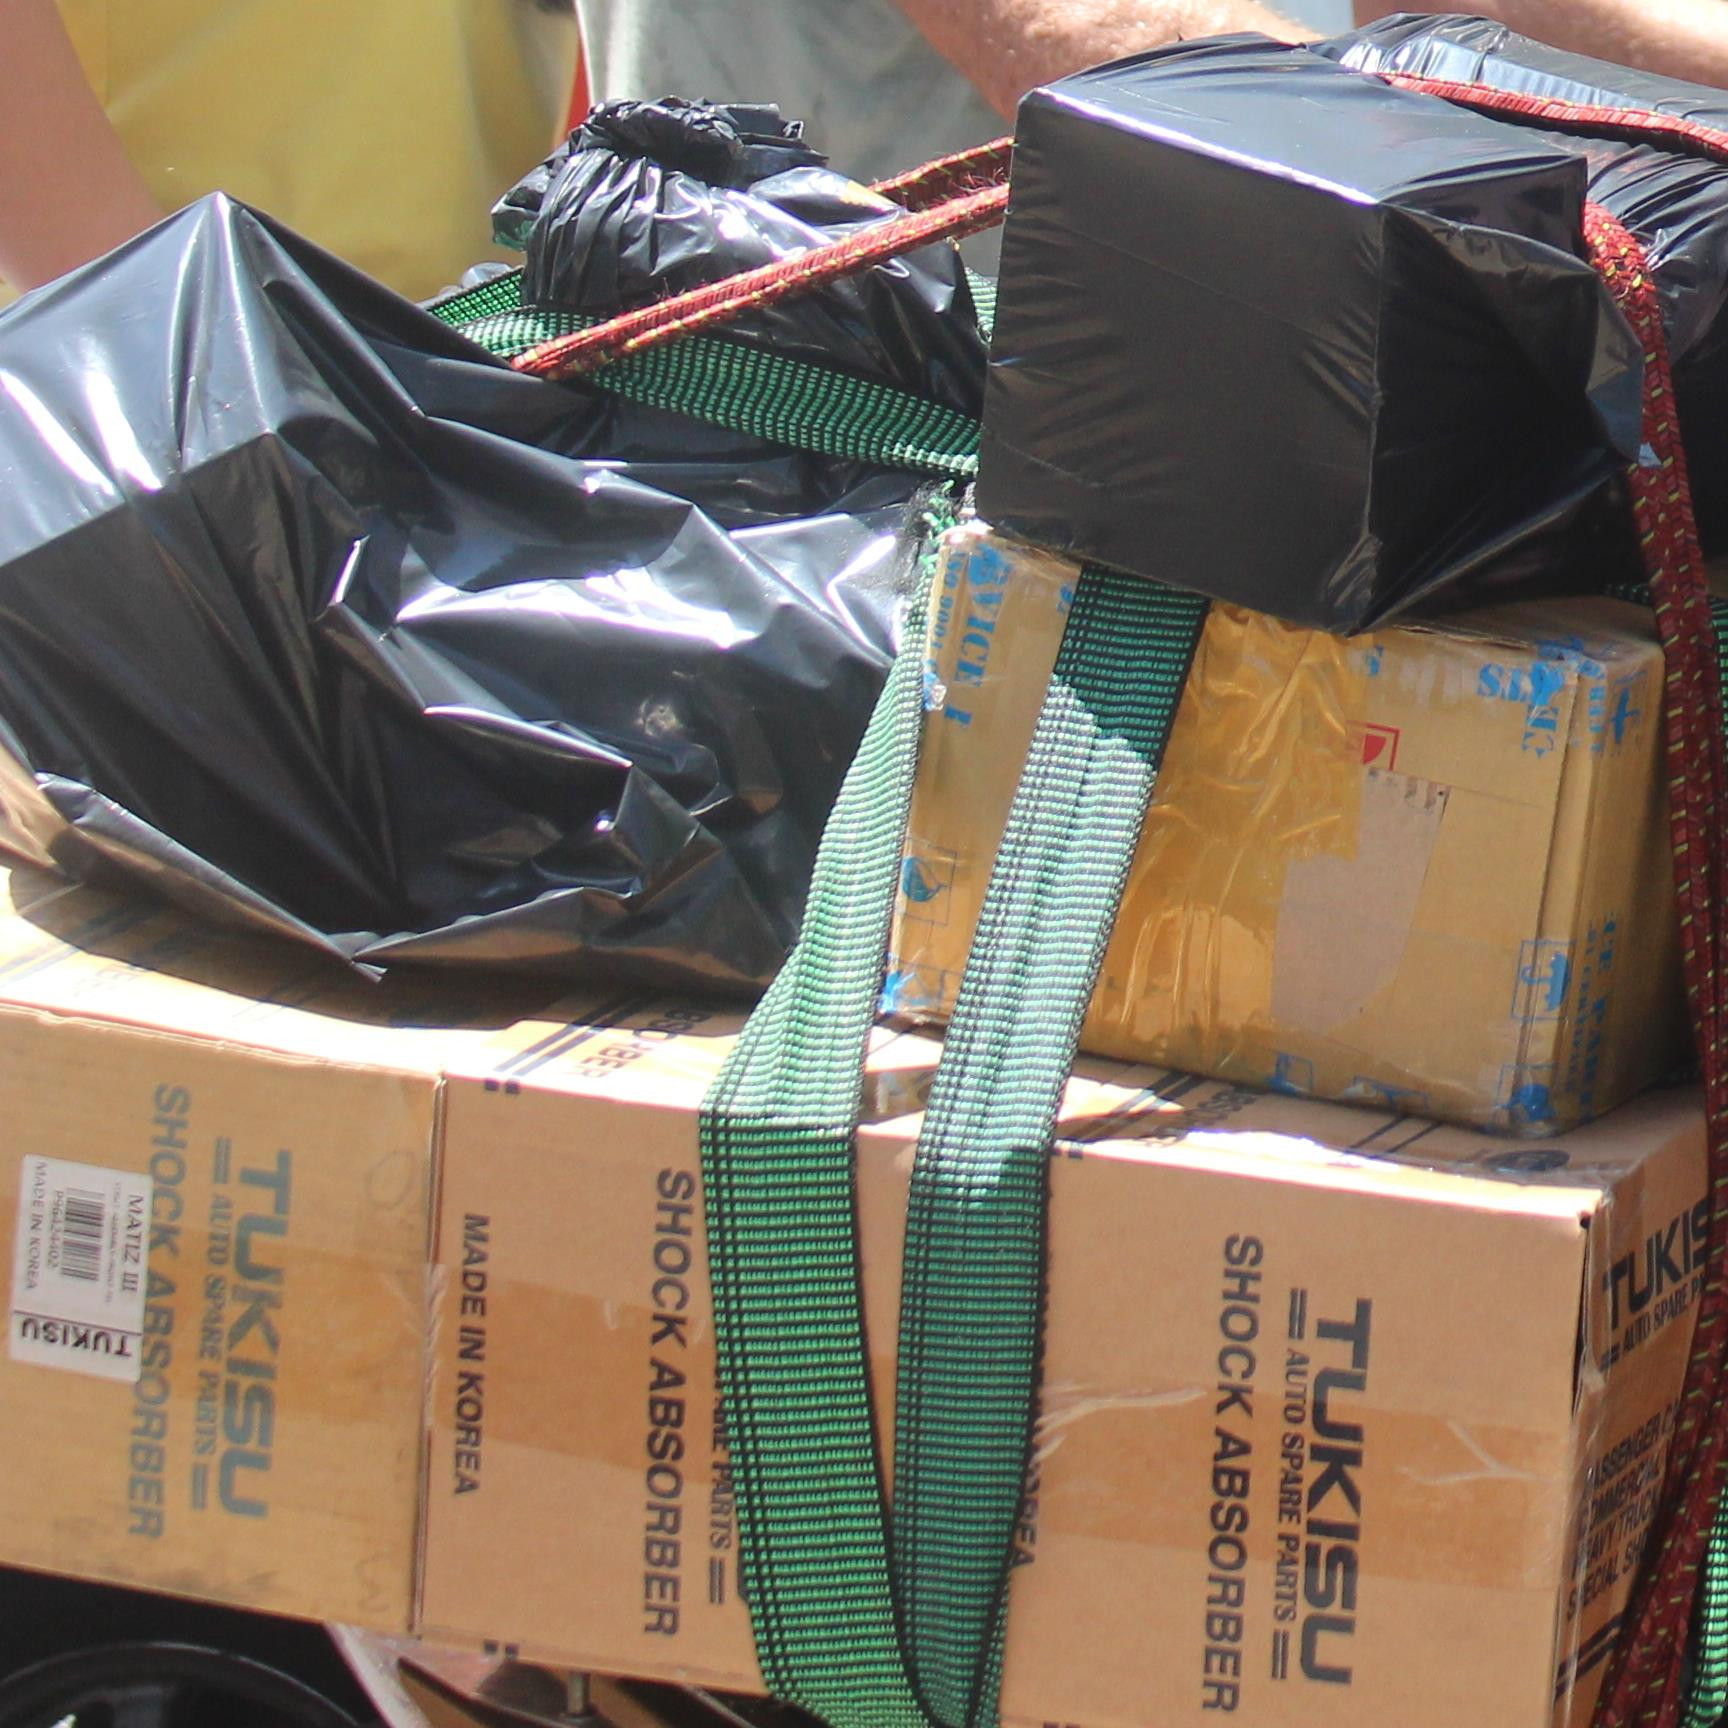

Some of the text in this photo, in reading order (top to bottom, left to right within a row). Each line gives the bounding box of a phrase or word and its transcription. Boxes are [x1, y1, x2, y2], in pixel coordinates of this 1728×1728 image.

[21, 1317, 133, 1358] TUKISU
[128, 1081, 192, 1541] SHOCK ABSORBER
[219, 1149, 293, 1519] TUKISU
[454, 1212, 491, 1496] MADE IN KOREA
[643, 1166, 696, 1638] SHOCK ABSORBER
[1202, 1232, 1265, 1715] SHOCK ABSORBER
[1273, 1348, 1311, 1624] AUTO SPARE PARTS
[1300, 1296, 1374, 1687] TUKISU
